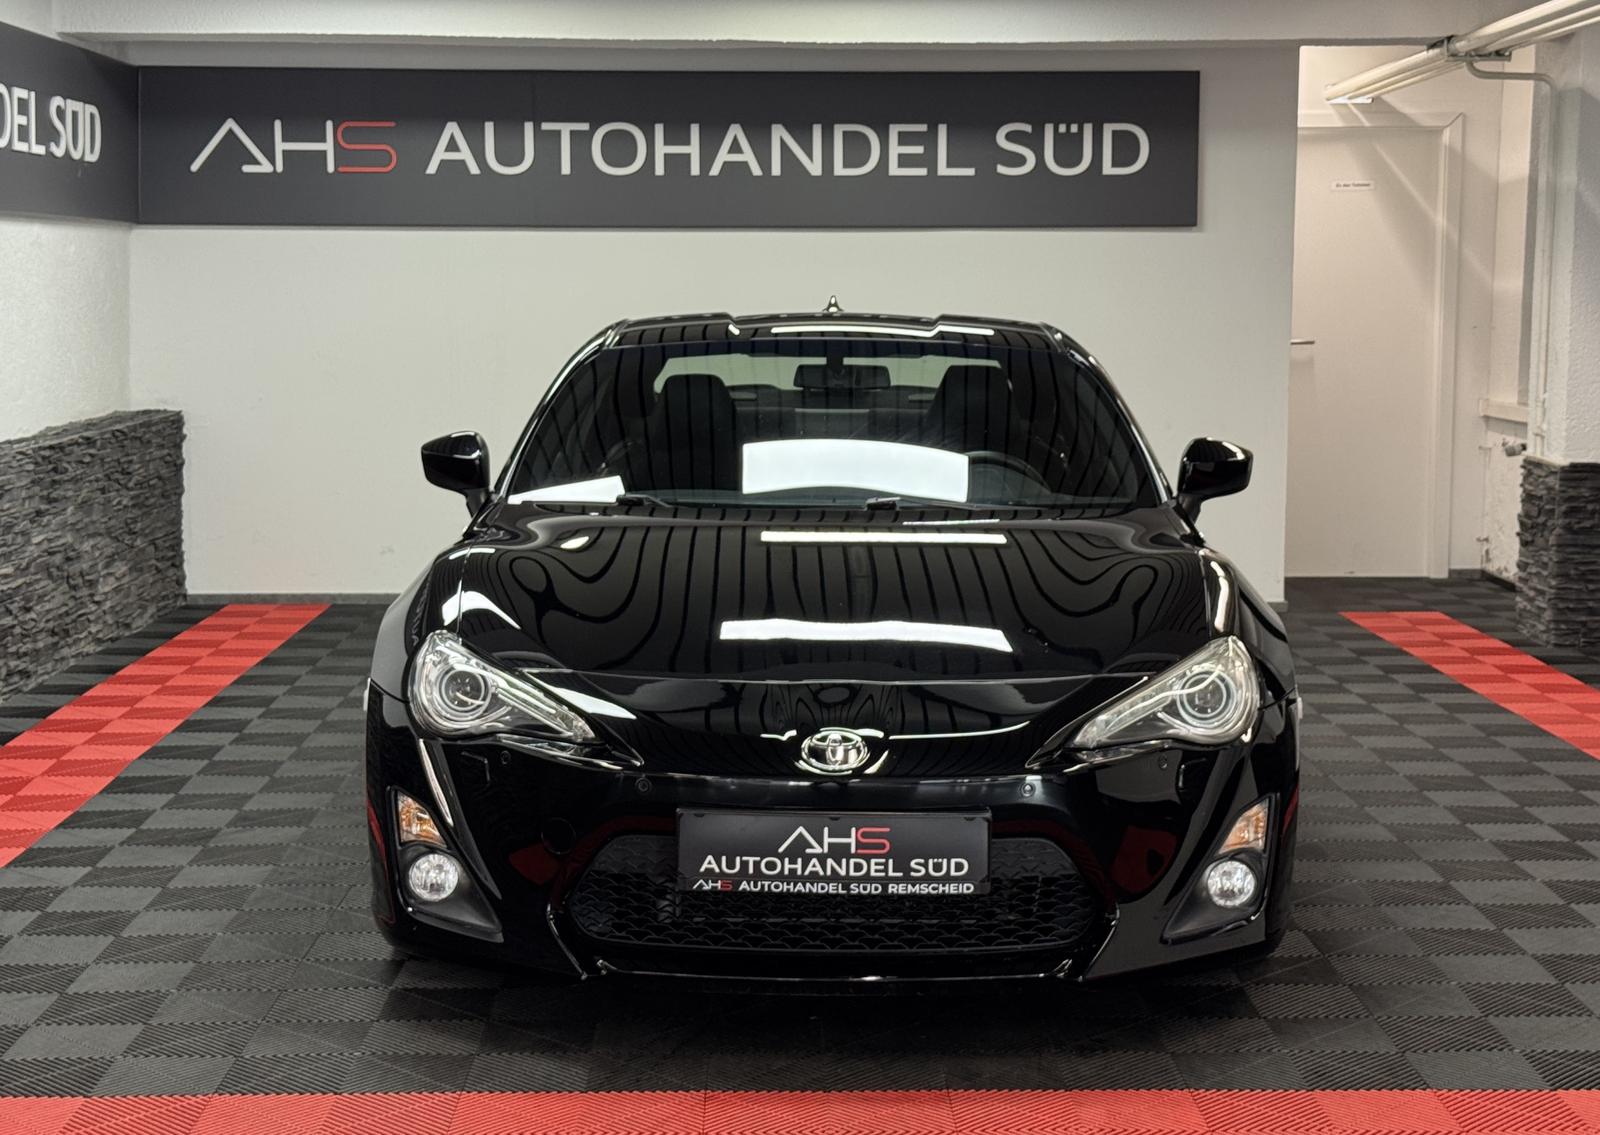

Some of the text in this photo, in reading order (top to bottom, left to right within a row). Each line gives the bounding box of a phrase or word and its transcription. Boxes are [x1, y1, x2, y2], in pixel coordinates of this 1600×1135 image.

[190, 117, 1151, 177] AHS AUTOHANDEL SÜD
[778, 826, 891, 854] AHS
[699, 855, 970, 877] AUTOHANDEL SÜD
[692, 879, 975, 894] AHS AUTOHANDEL SÜD REMSCHEID
